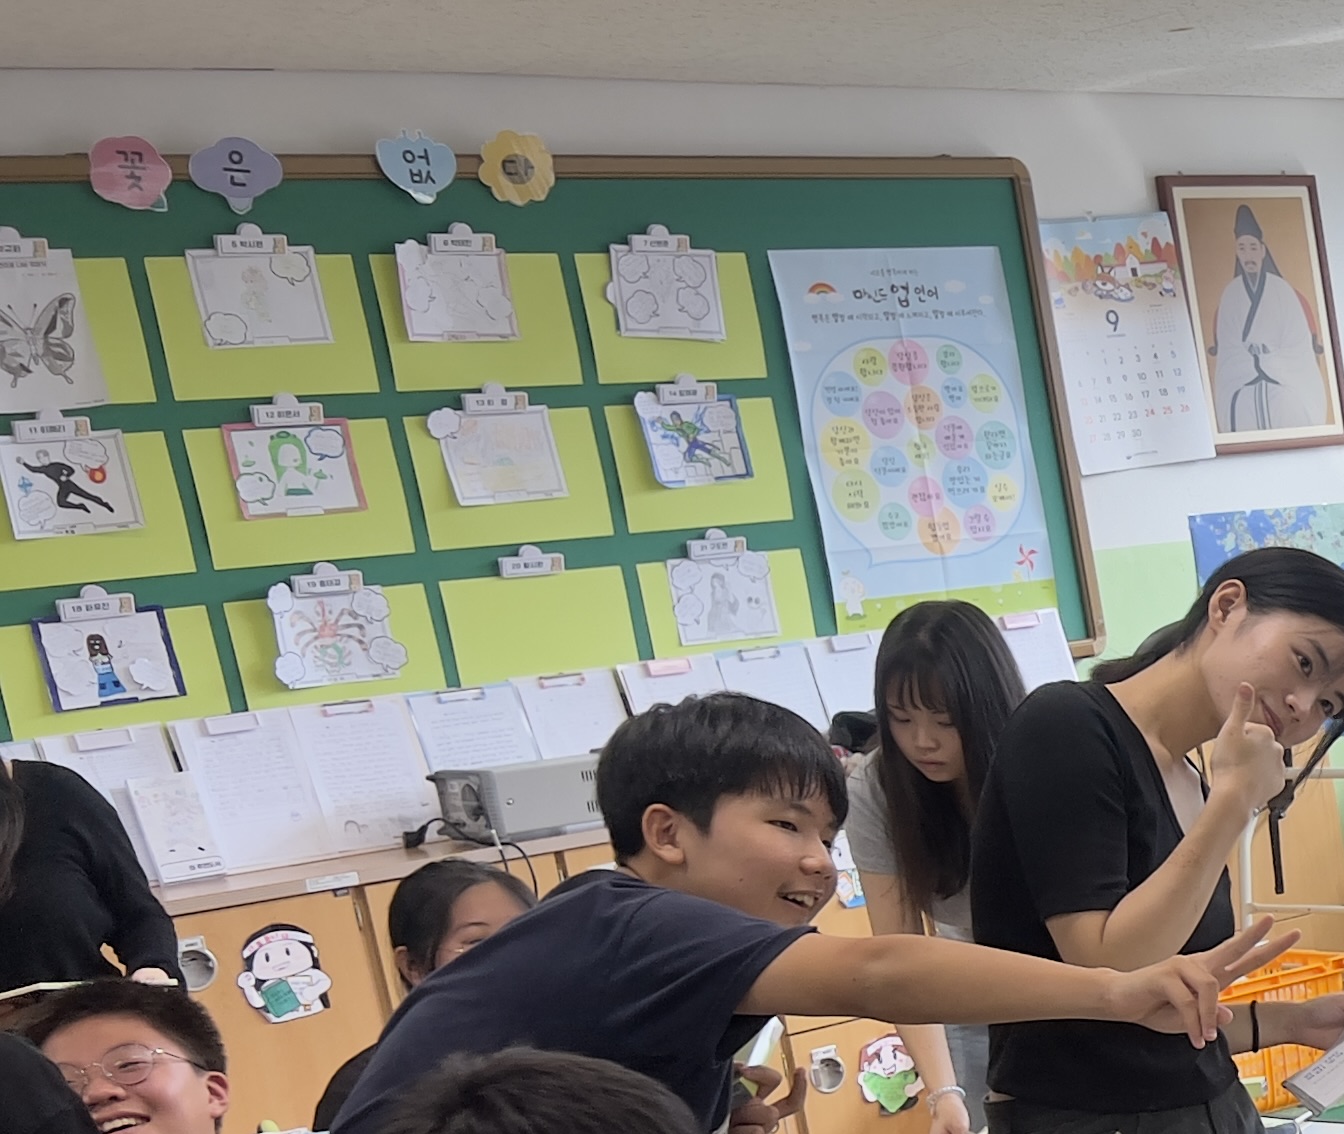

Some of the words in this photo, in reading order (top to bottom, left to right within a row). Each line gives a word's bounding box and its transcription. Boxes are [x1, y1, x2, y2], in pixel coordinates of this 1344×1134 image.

[890, 282, 910, 307] 업
[1106, 310, 1119, 332] 9
[1119, 356, 1123, 364] 2
[1136, 355, 1141, 363] 3
[1107, 376, 1112, 384] 8
[1122, 374, 1127, 382] 9
[1137, 372, 1147, 381] 10
[1155, 370, 1164, 378] 11
[1173, 368, 1182, 376] 12
[1125, 393, 1133, 401] 16
[1141, 390, 1149, 399] 17
[1159, 388, 1168, 396] 18
[1177, 386, 1185, 394] 19
[1113, 413, 1122, 421] 22
[1128, 411, 1137, 419] 23
[1145, 409, 1155, 417] 24
[1163, 406, 1173, 415] 25
[1180, 404, 1190, 412] 26
[1117, 431, 1125, 439] 29
[1132, 429, 1142, 437] 30
